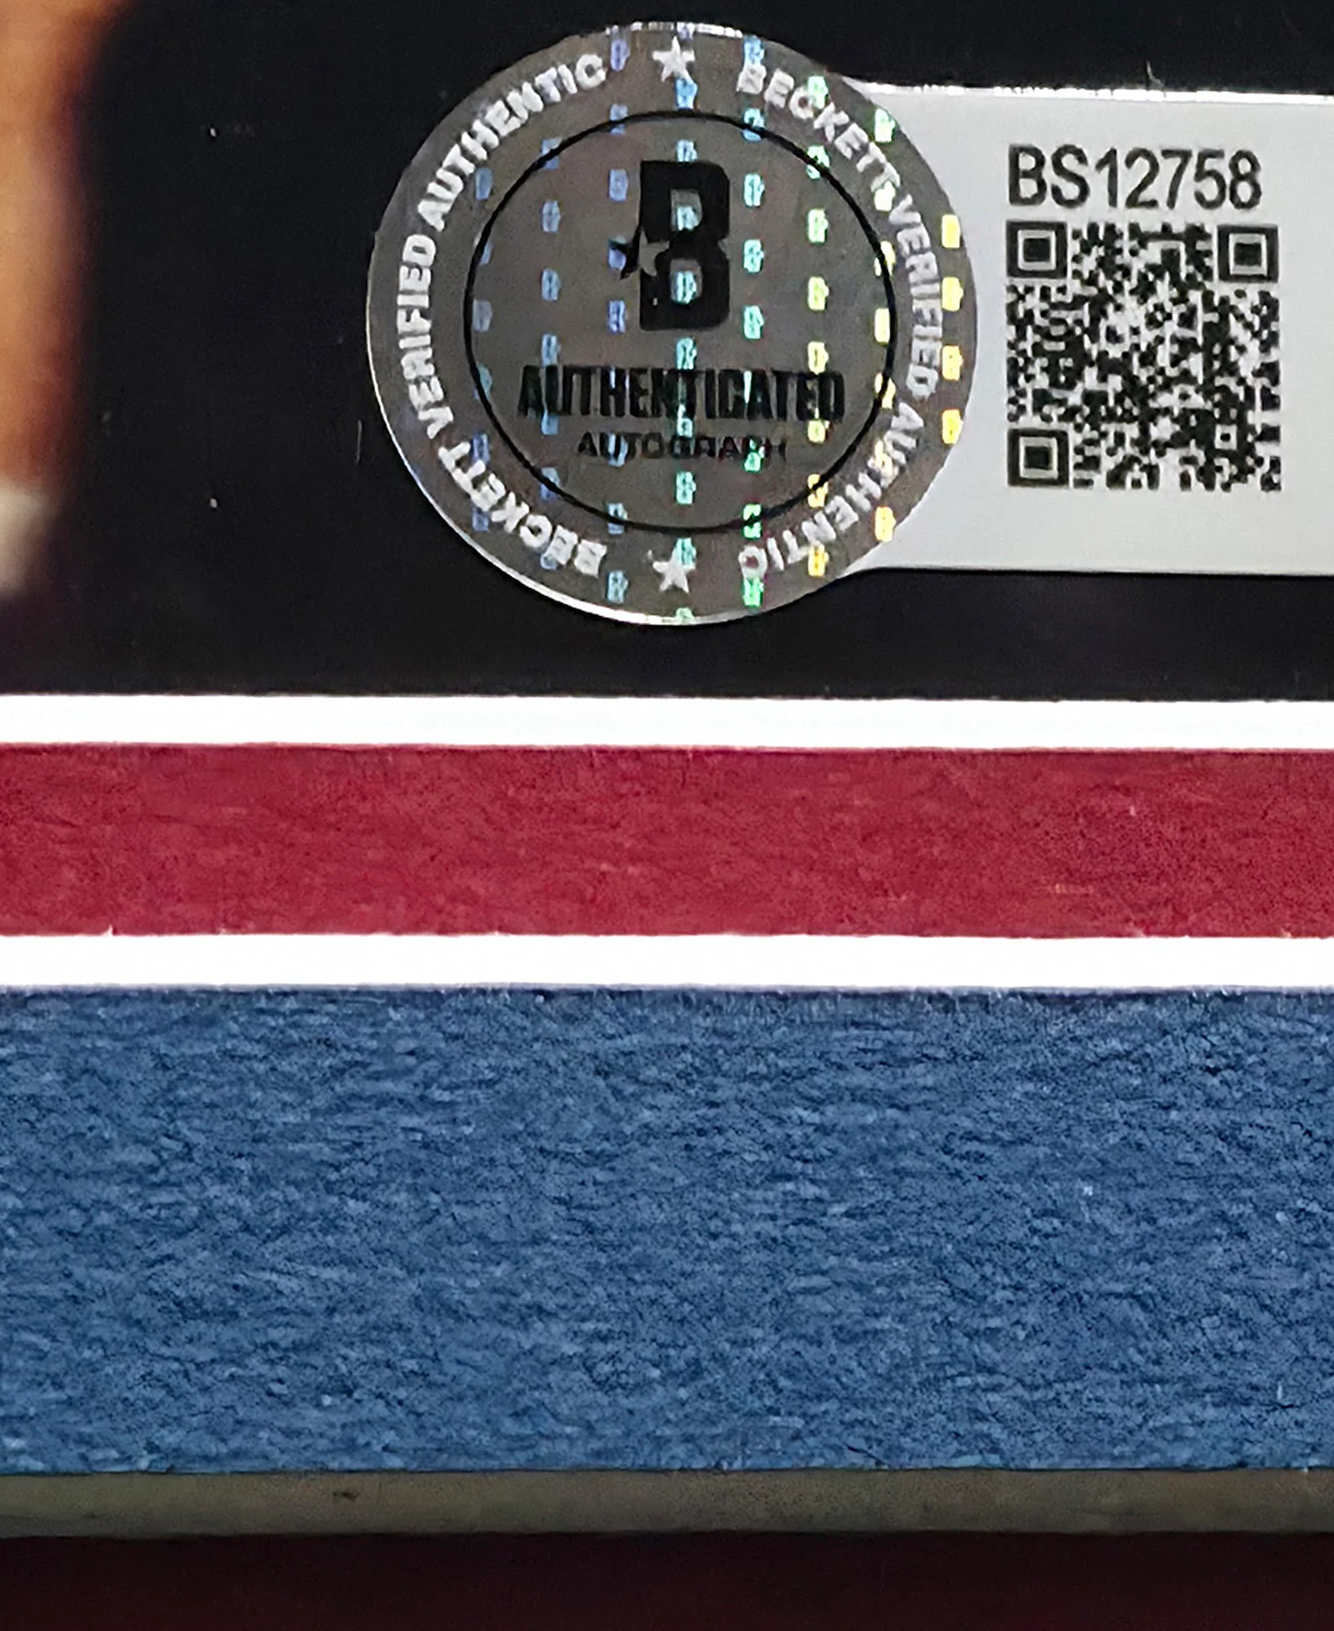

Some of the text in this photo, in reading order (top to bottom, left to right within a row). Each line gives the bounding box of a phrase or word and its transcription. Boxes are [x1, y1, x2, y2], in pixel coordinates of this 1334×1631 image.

[1007, 143, 1263, 210] BS12758
[396, 53, 608, 578] BECKETT VERIFIED AUTHENTIC
[736, 64, 943, 578] BECKETT VERIFIED AUTHENTIC
[518, 364, 846, 422] AUTHENTICATED
[577, 431, 787, 462] AUTOGRAPH
